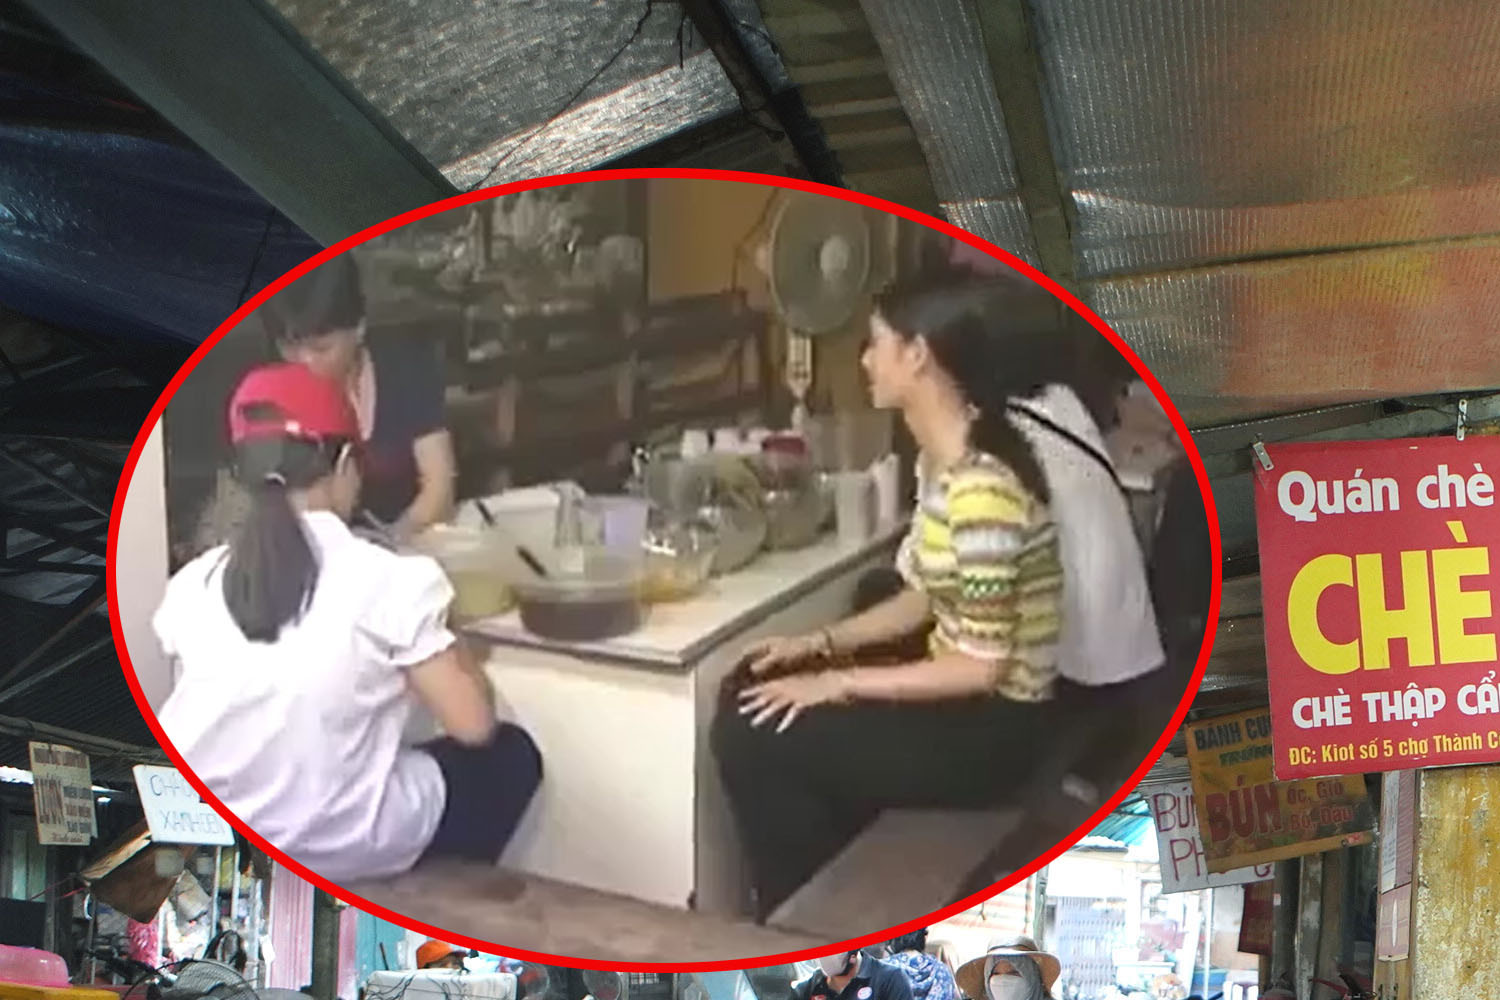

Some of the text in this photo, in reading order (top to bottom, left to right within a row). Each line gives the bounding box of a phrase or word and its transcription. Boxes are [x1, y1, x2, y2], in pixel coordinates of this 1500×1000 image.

[1277, 468, 1400, 522] Quán
[1416, 463, 1495, 509] chè
[1287, 520, 1498, 675] CHÈ
[1292, 688, 1352, 729] CHÈ
[1362, 682, 1446, 727] THẬP
[1289, 747, 1317, 765] ĐC:
[1321, 742, 1354, 762] Kiot
[1359, 736, 1378, 759] số
[1383, 739, 1393, 757] 5
[1399, 737, 1428, 758] chợ
[1433, 732, 1482, 753] Thành
[1206, 774, 1282, 842] BÚN
